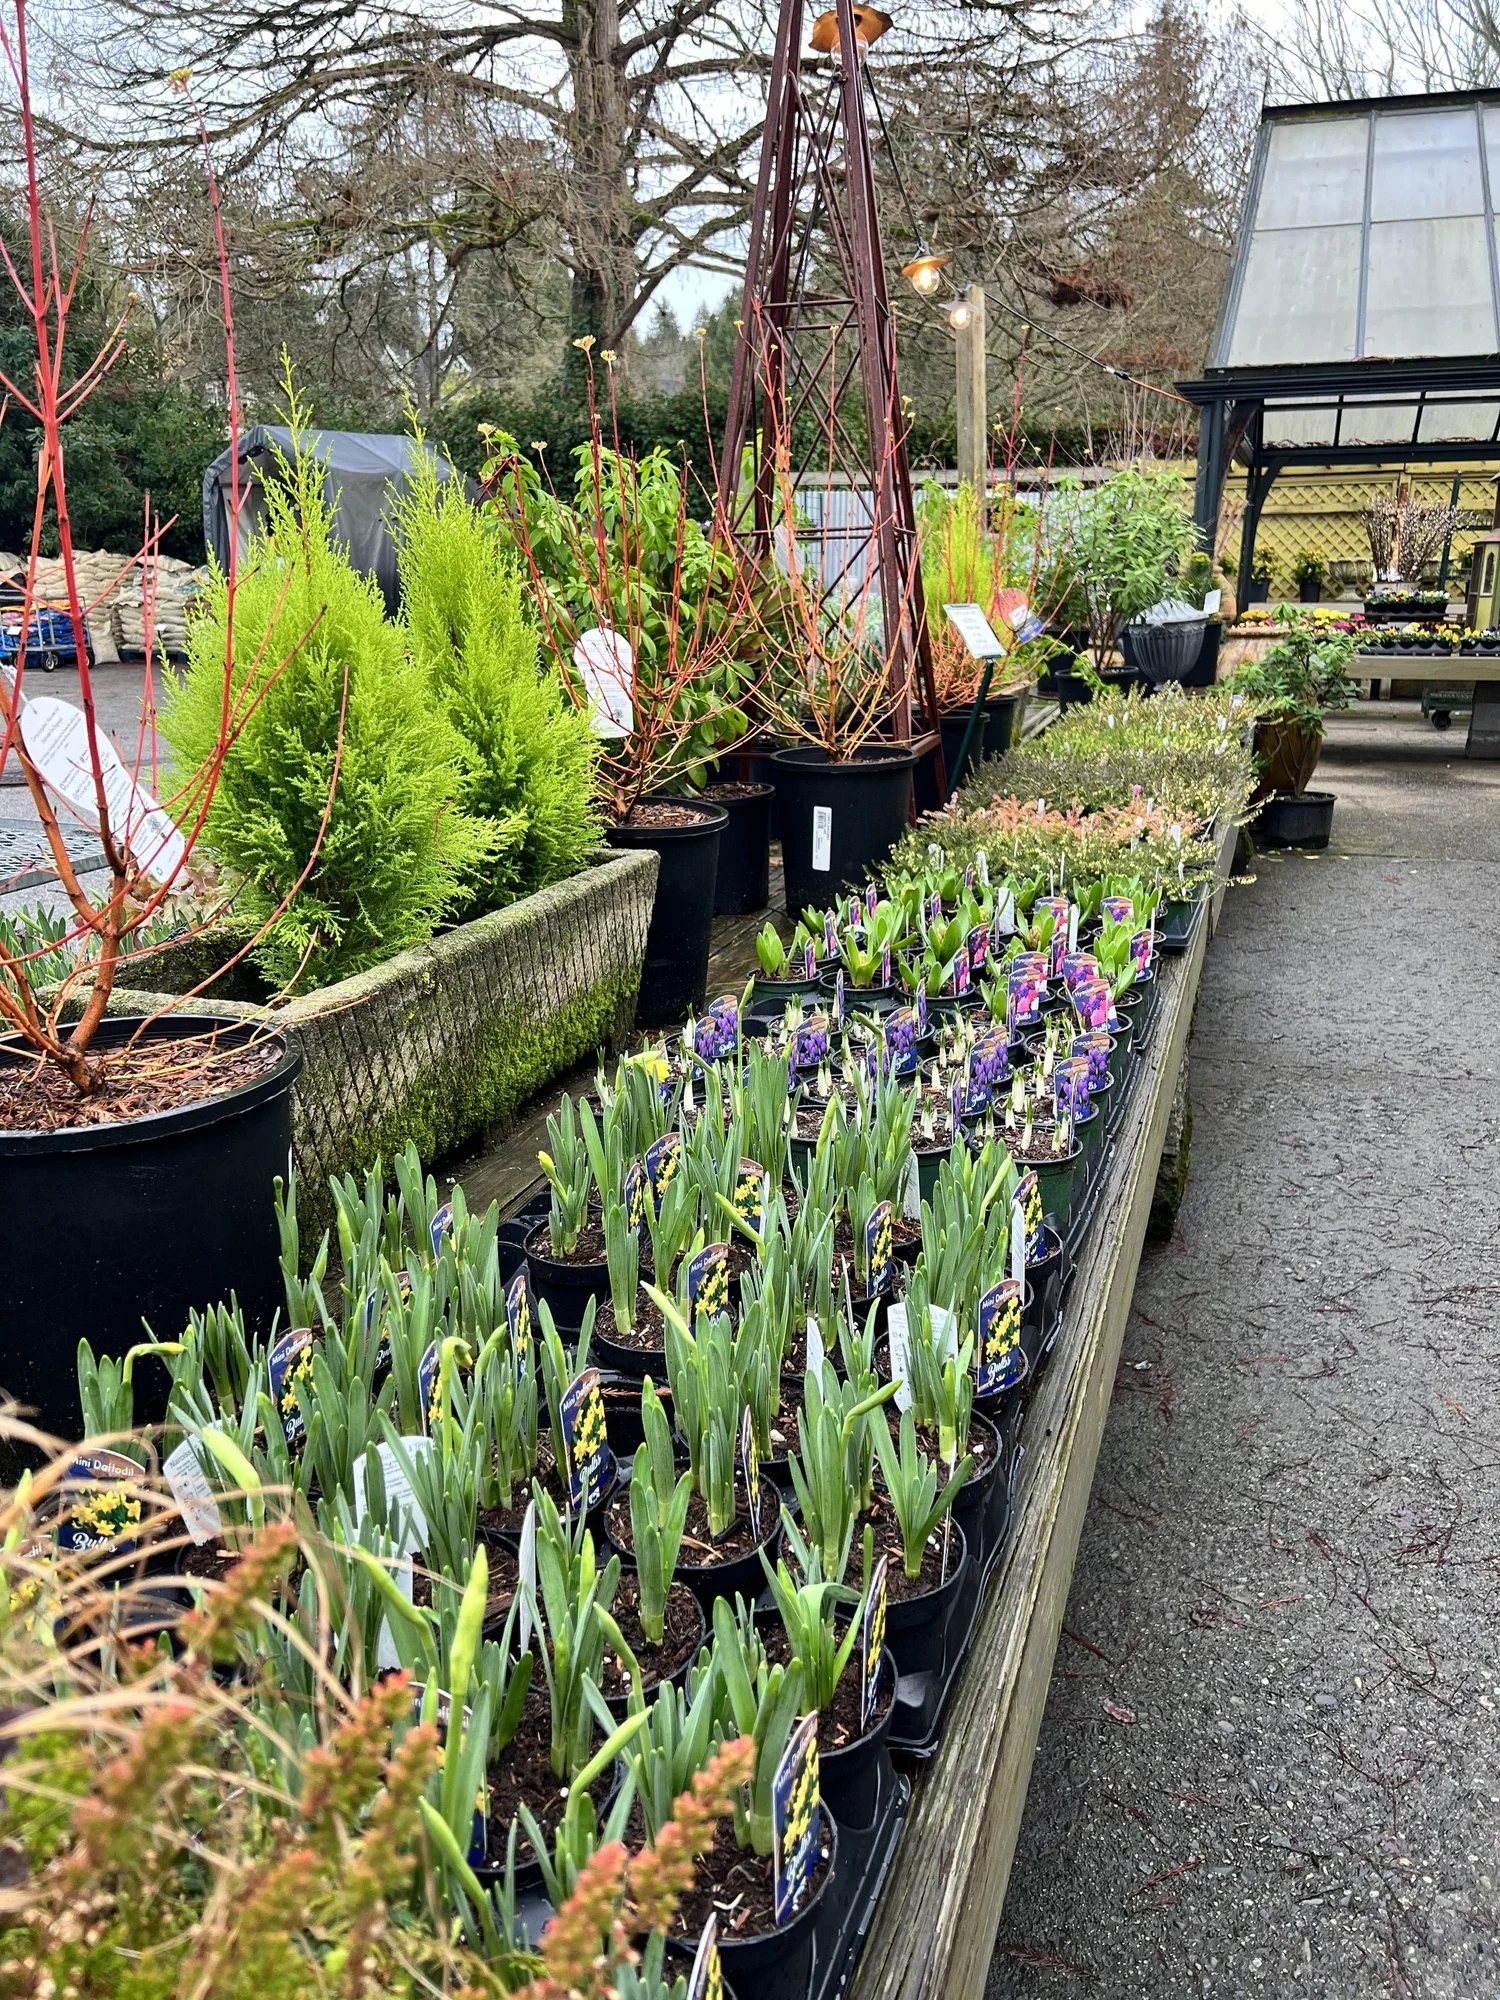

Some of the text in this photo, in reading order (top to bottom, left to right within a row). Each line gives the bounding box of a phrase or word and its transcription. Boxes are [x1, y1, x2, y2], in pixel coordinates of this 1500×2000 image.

[690, 1260, 703, 1273] Mini
[982, 1296, 995, 1310] Mini
[272, 1350, 286, 1366] Mini
[987, 1355, 1011, 1382] Bulbs
[563, 1397, 576, 1413] Mini
[93, 1459, 135, 1477] Daffodil
